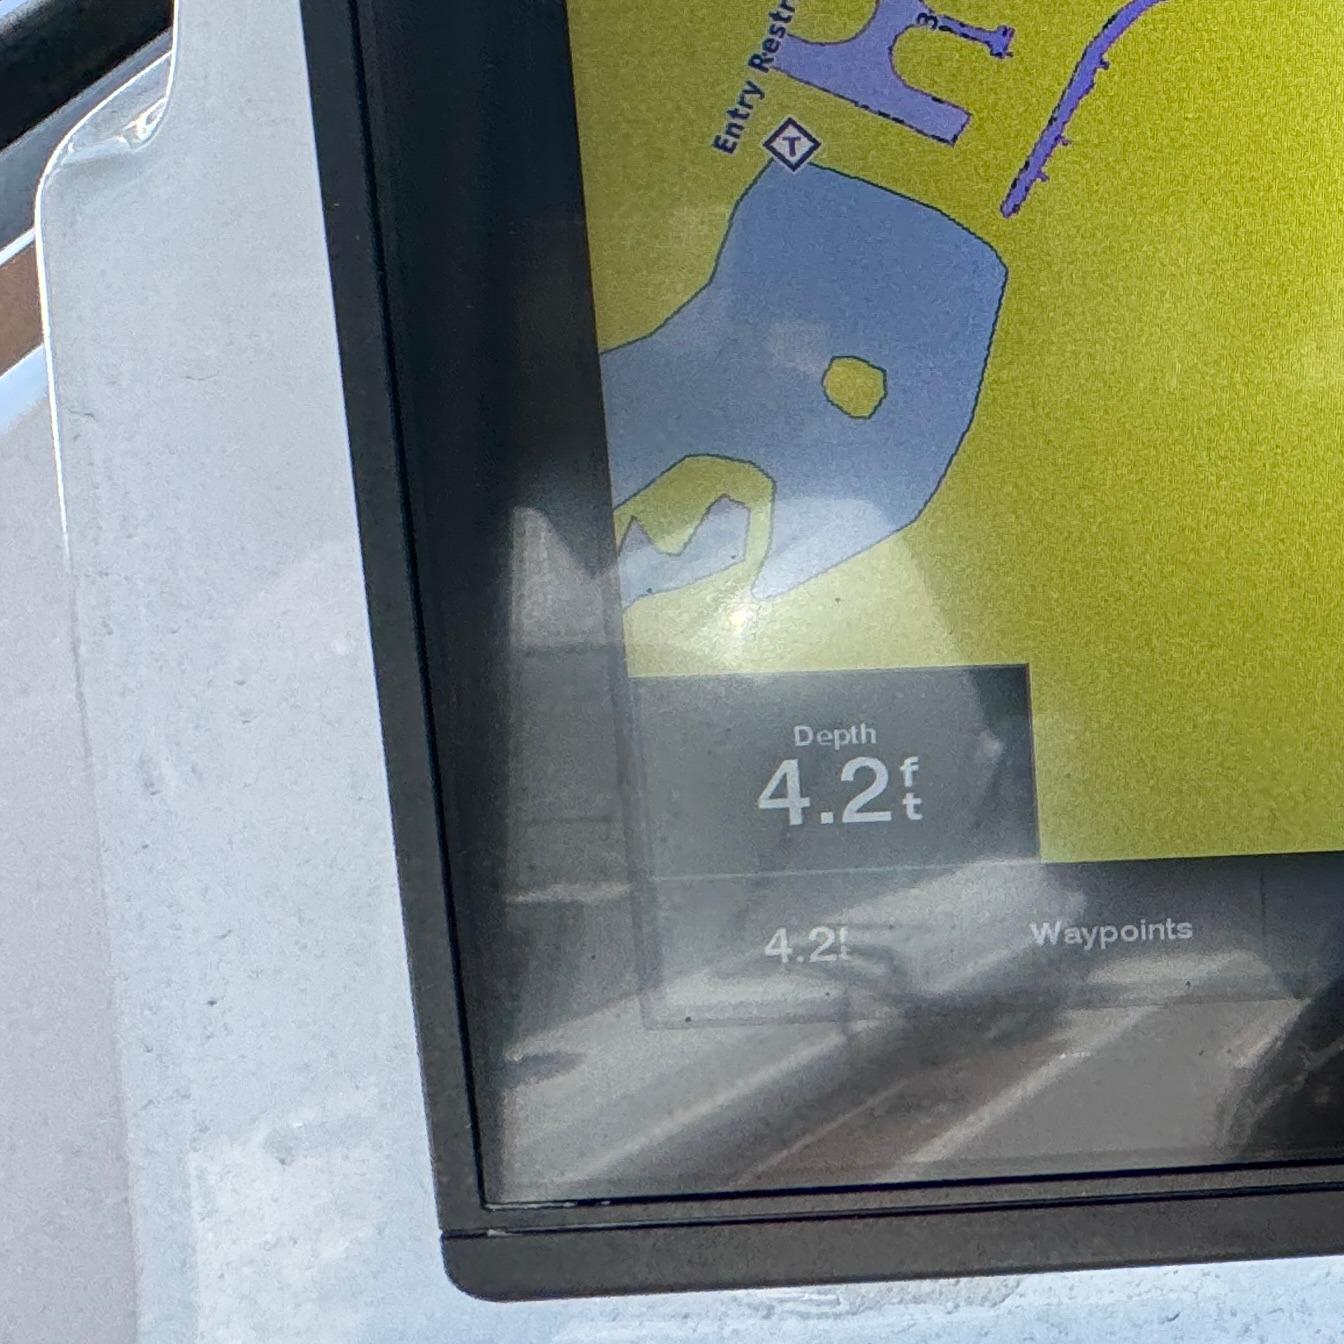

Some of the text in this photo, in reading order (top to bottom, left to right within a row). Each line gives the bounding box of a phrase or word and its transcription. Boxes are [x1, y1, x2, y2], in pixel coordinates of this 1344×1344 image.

[713, 80, 766, 154] Entry
[793, 724, 876, 749] Depth
[757, 756, 892, 825] 4.2
[1030, 917, 1194, 950] Waypoints
